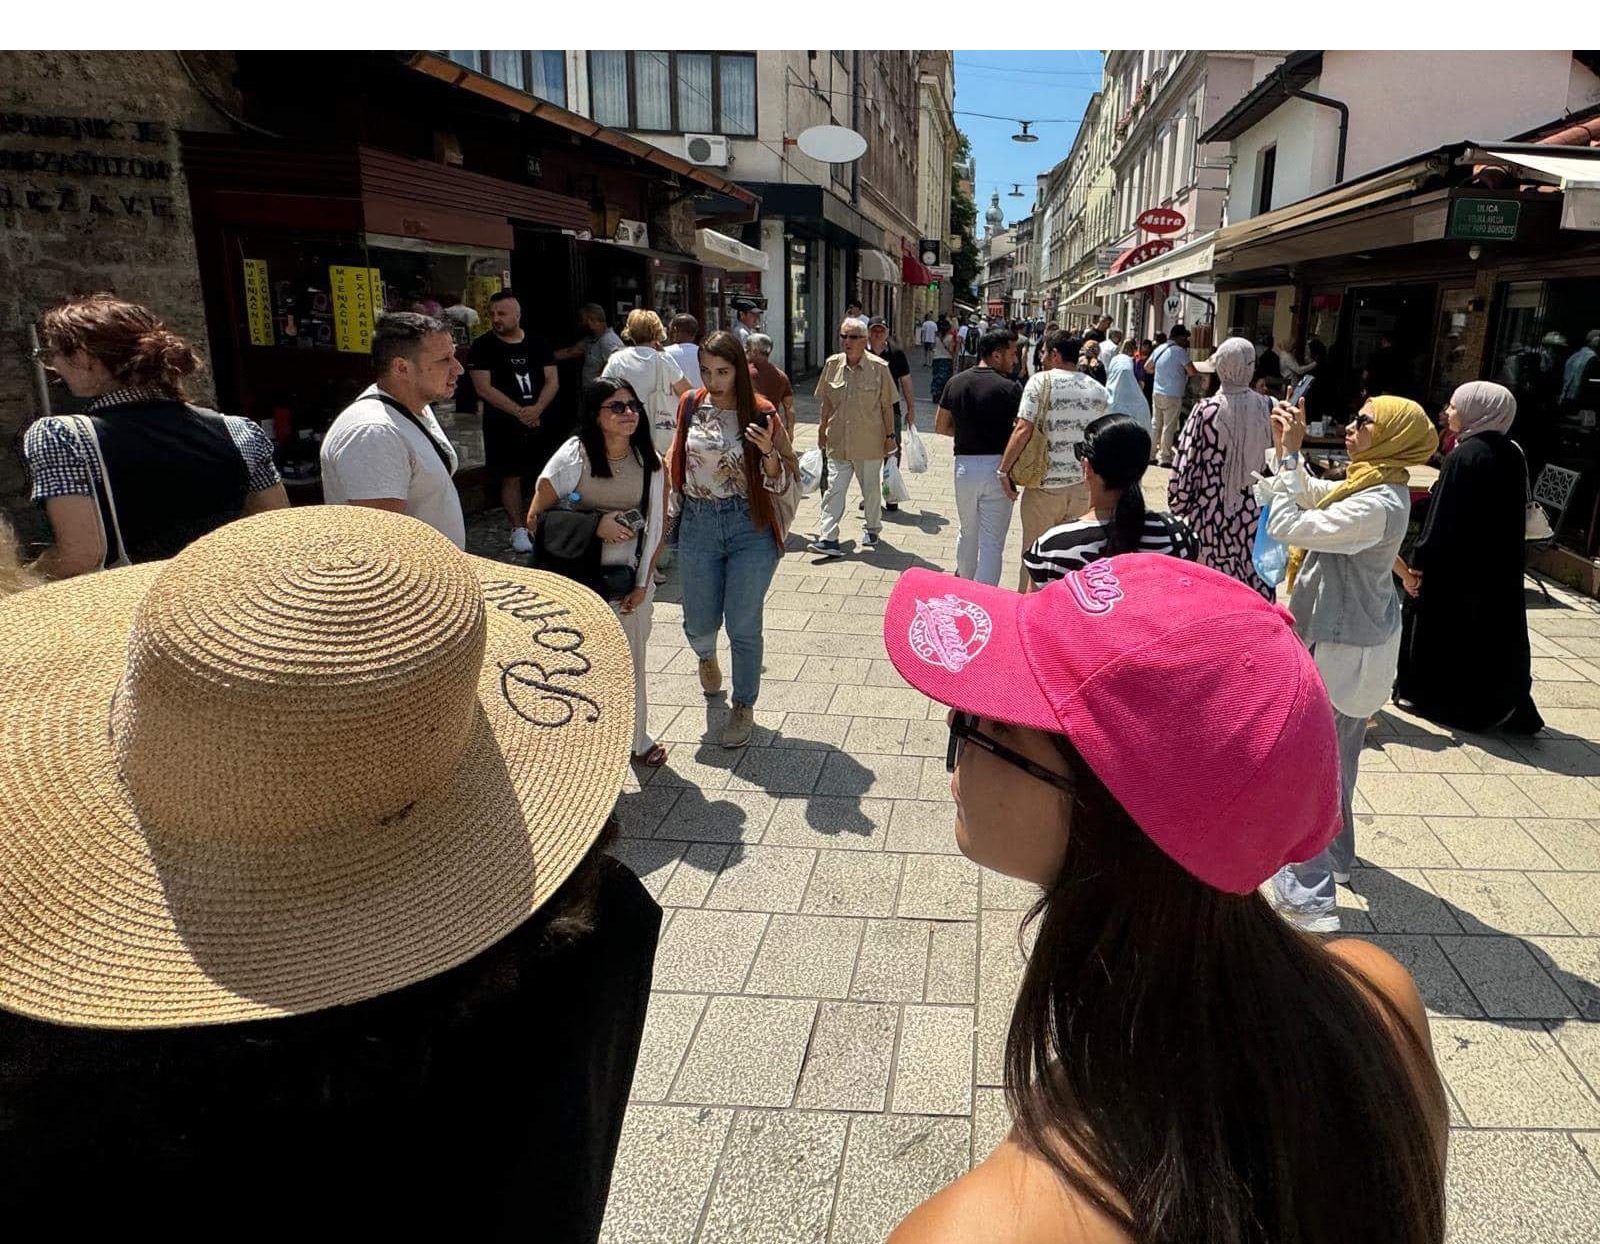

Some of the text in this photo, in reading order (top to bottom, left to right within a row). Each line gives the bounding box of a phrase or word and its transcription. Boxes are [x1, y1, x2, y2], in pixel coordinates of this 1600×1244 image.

[1141, 215, 1182, 226] Astra
[1477, 203, 1499, 213] ULICA
[259, 267, 271, 339] EXCHANGE
[355, 273, 369, 346] EXCHANGE
[913, 619, 933, 657] CARLO
[965, 603, 990, 642] MONTE
